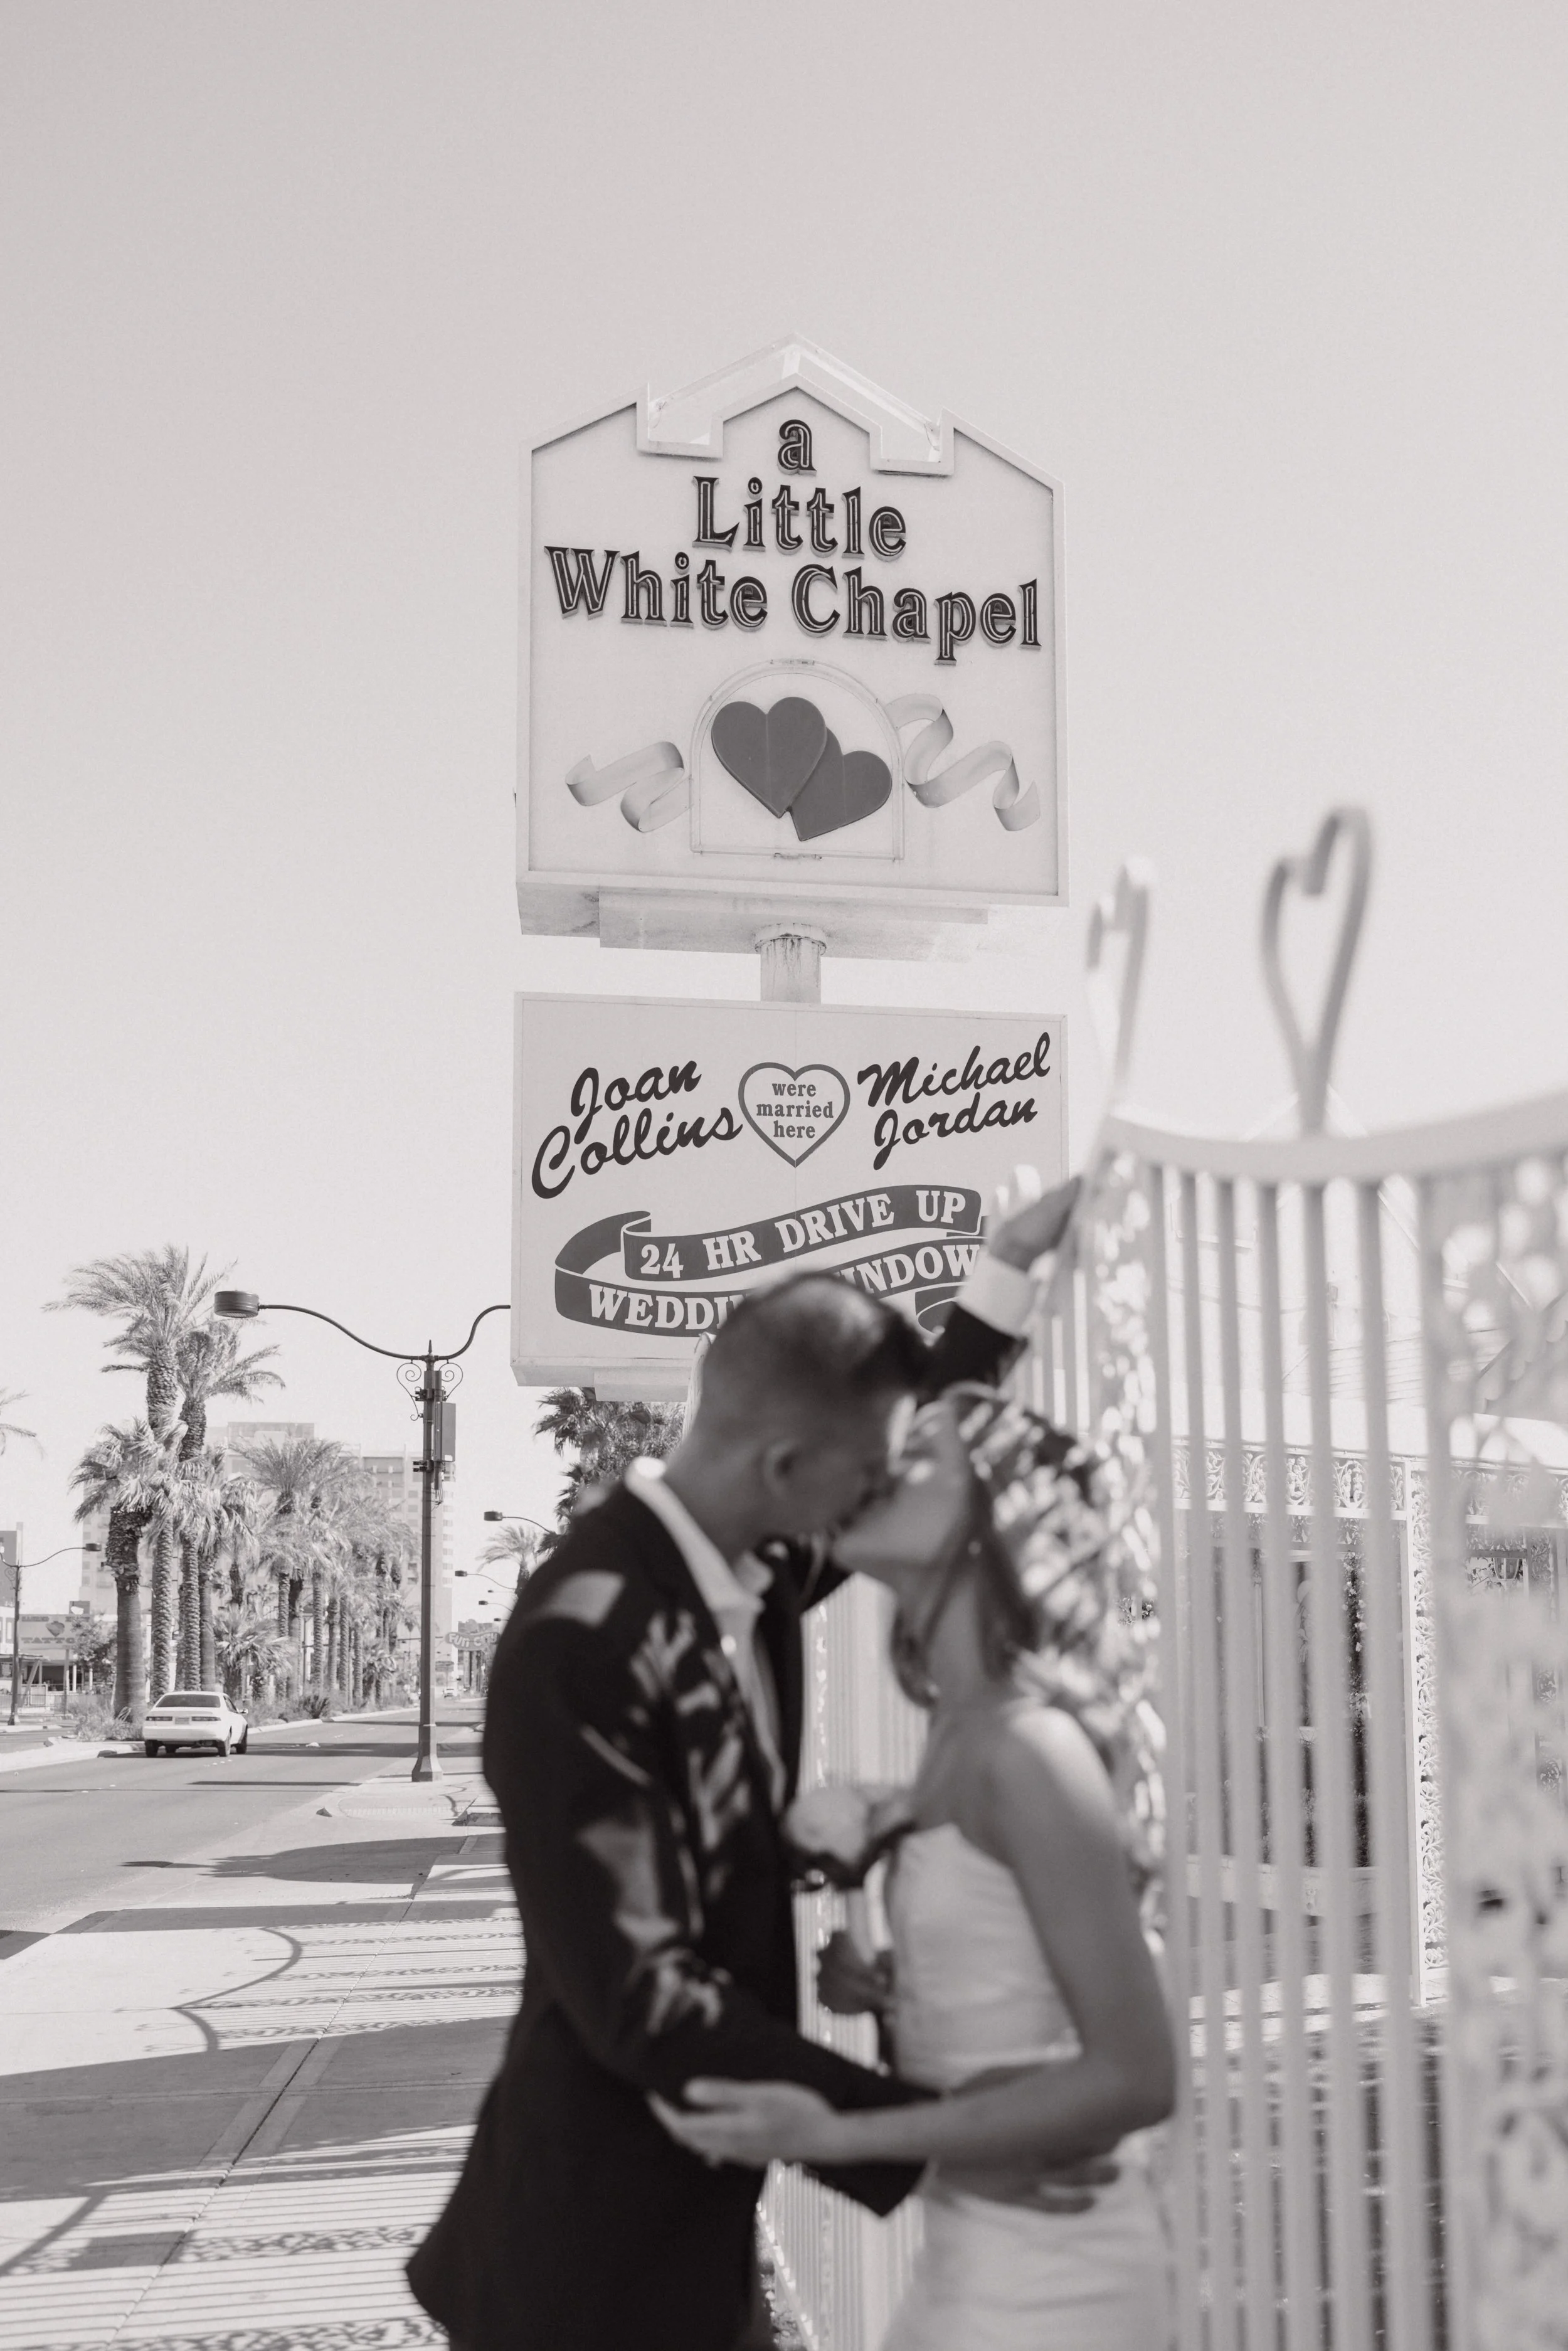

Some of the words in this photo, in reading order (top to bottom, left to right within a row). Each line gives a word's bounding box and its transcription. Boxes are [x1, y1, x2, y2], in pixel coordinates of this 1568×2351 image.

[778, 420, 817, 475] a
[692, 476, 907, 560] Little
[544, 546, 768, 630] White
[792, 564, 1042, 666] Chapel
[571, 1060, 702, 1145] Joan
[756, 1101, 834, 1118] married
[771, 1083, 817, 1097] were
[857, 1032, 1051, 1108] Michael
[531, 1107, 743, 1199] Collins
[773, 1120, 815, 1138] here
[873, 1091, 1038, 1170] Jordan
[640, 1243, 684, 1278] 24
[702, 1230, 762, 1271] HR
[775, 1193, 895, 1253] DRIVE
[916, 1190, 966, 1224] UP
[589, 1283, 753, 1330] WEDDI
[833, 1244, 980, 1293] INDOW
